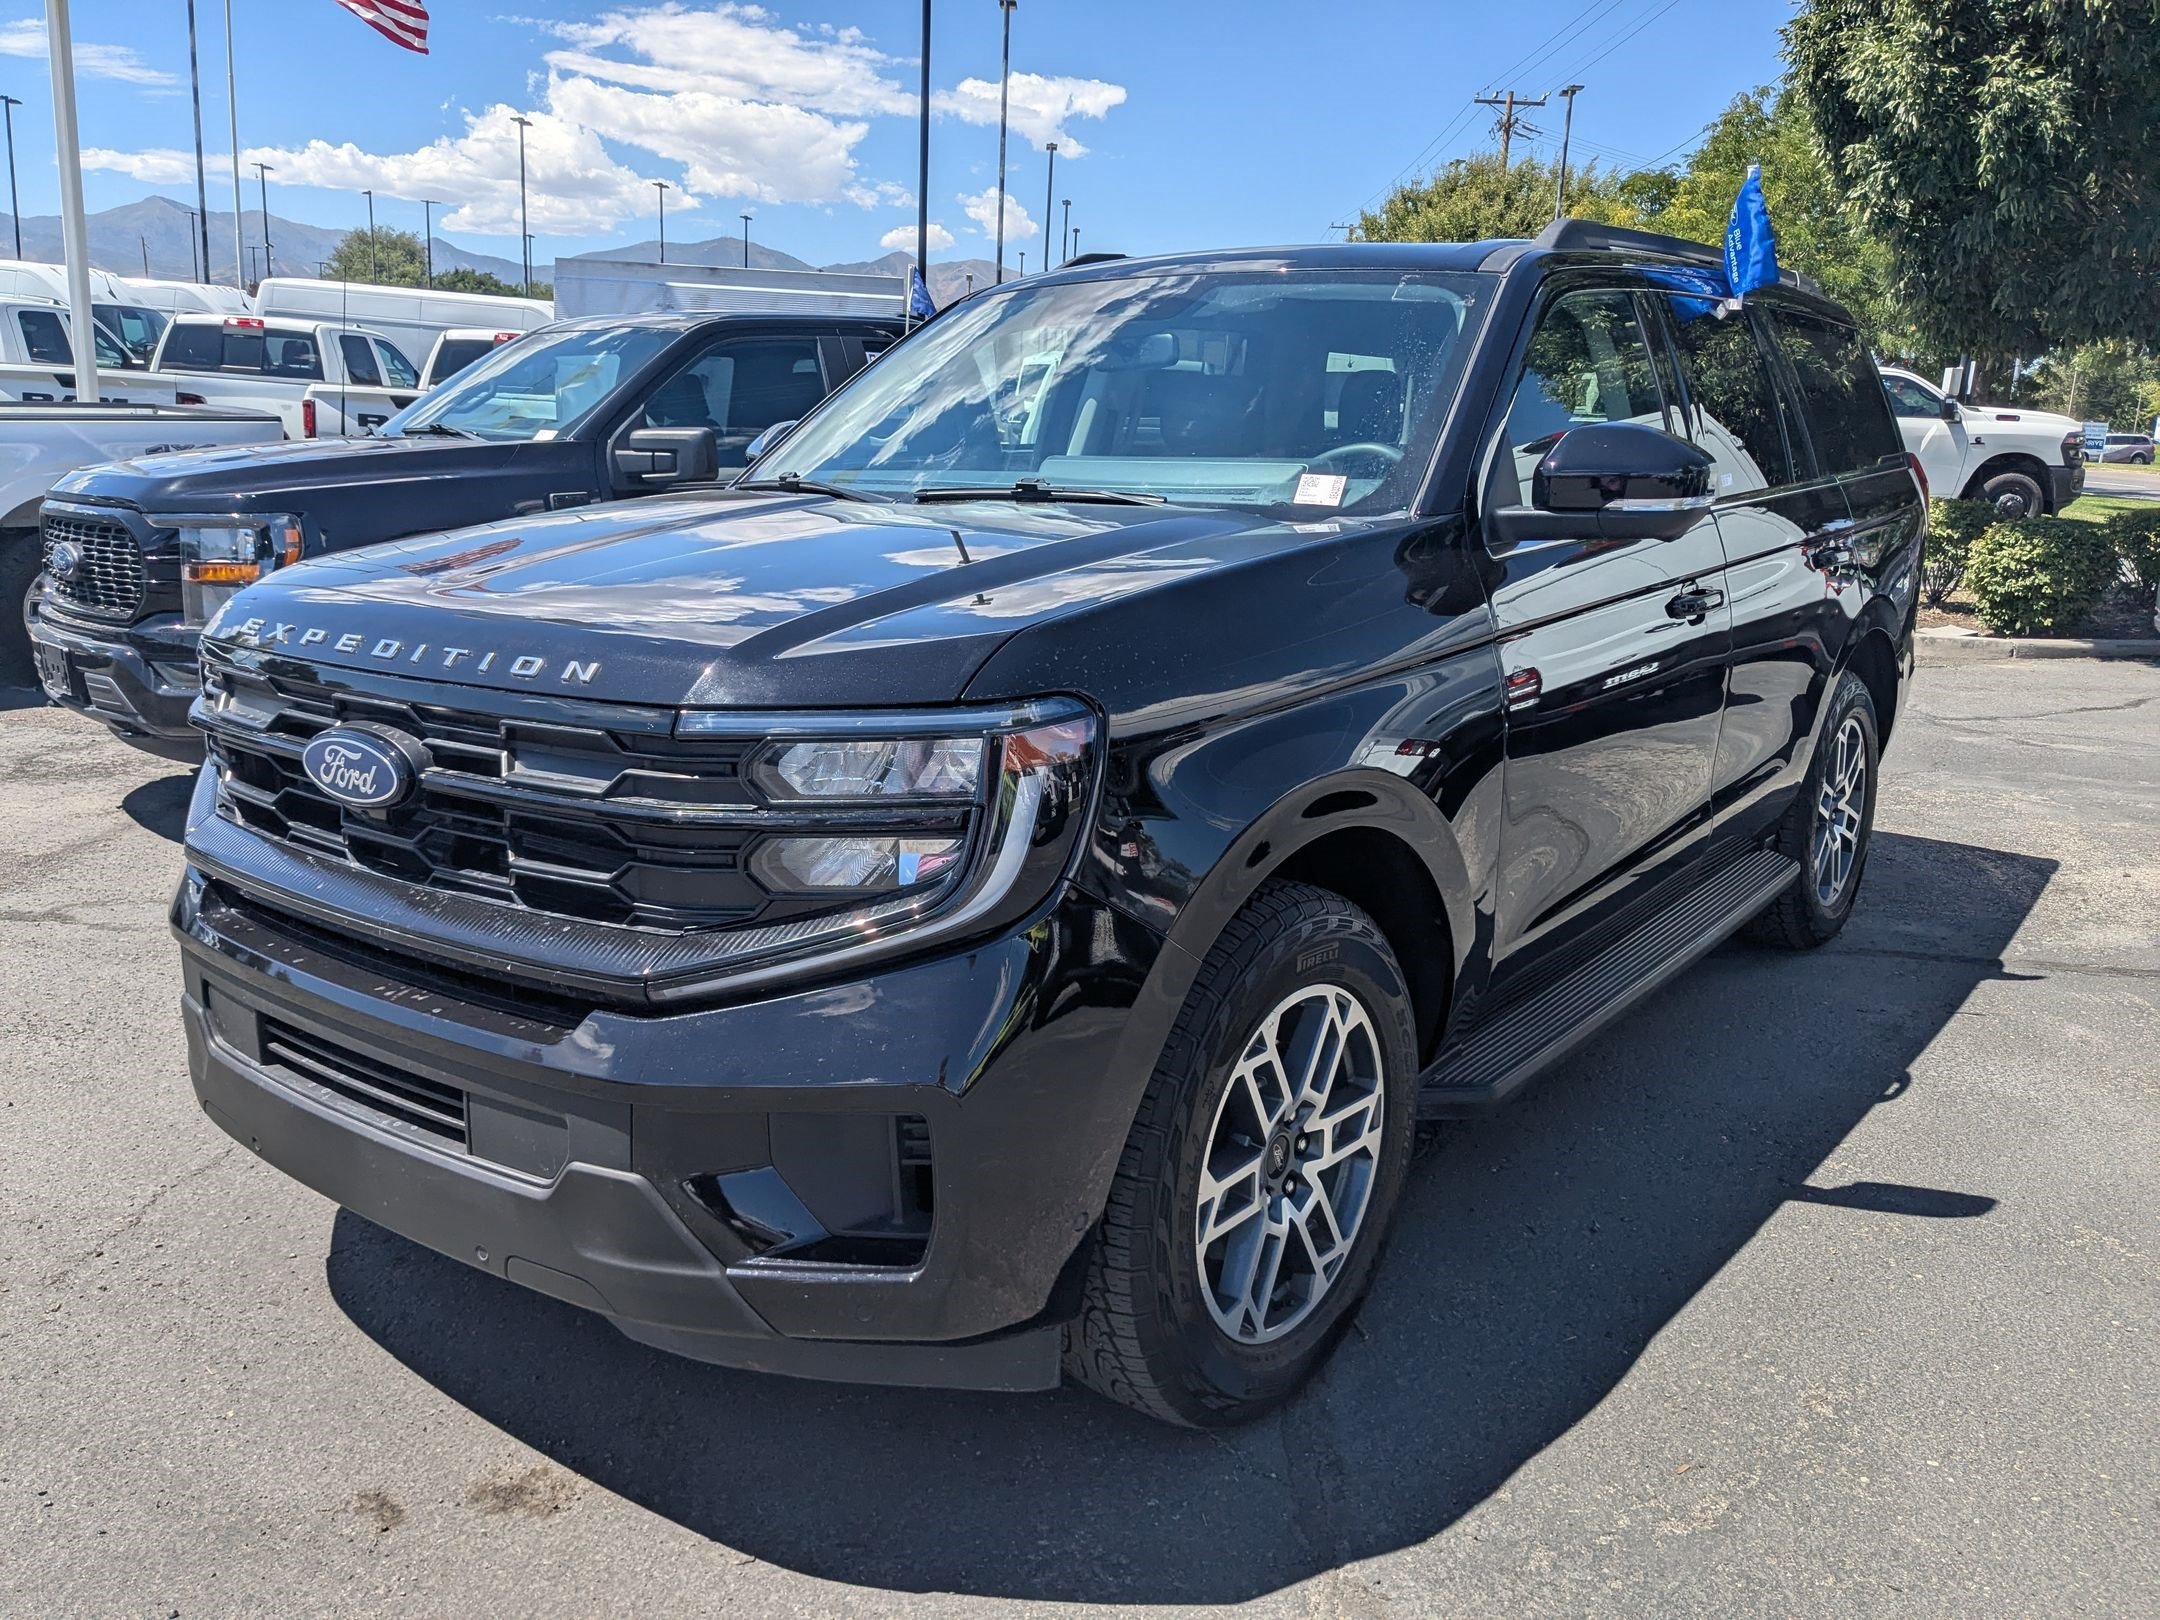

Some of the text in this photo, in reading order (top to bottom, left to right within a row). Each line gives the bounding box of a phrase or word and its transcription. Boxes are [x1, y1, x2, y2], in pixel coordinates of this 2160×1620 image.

[1728, 234, 1739, 283] Advantage
[1733, 228, 1742, 250] Blue
[239, 617, 602, 683] EXPEDITION
[320, 744, 377, 795] Ford
[1296, 941, 1340, 973] PIRELLI
